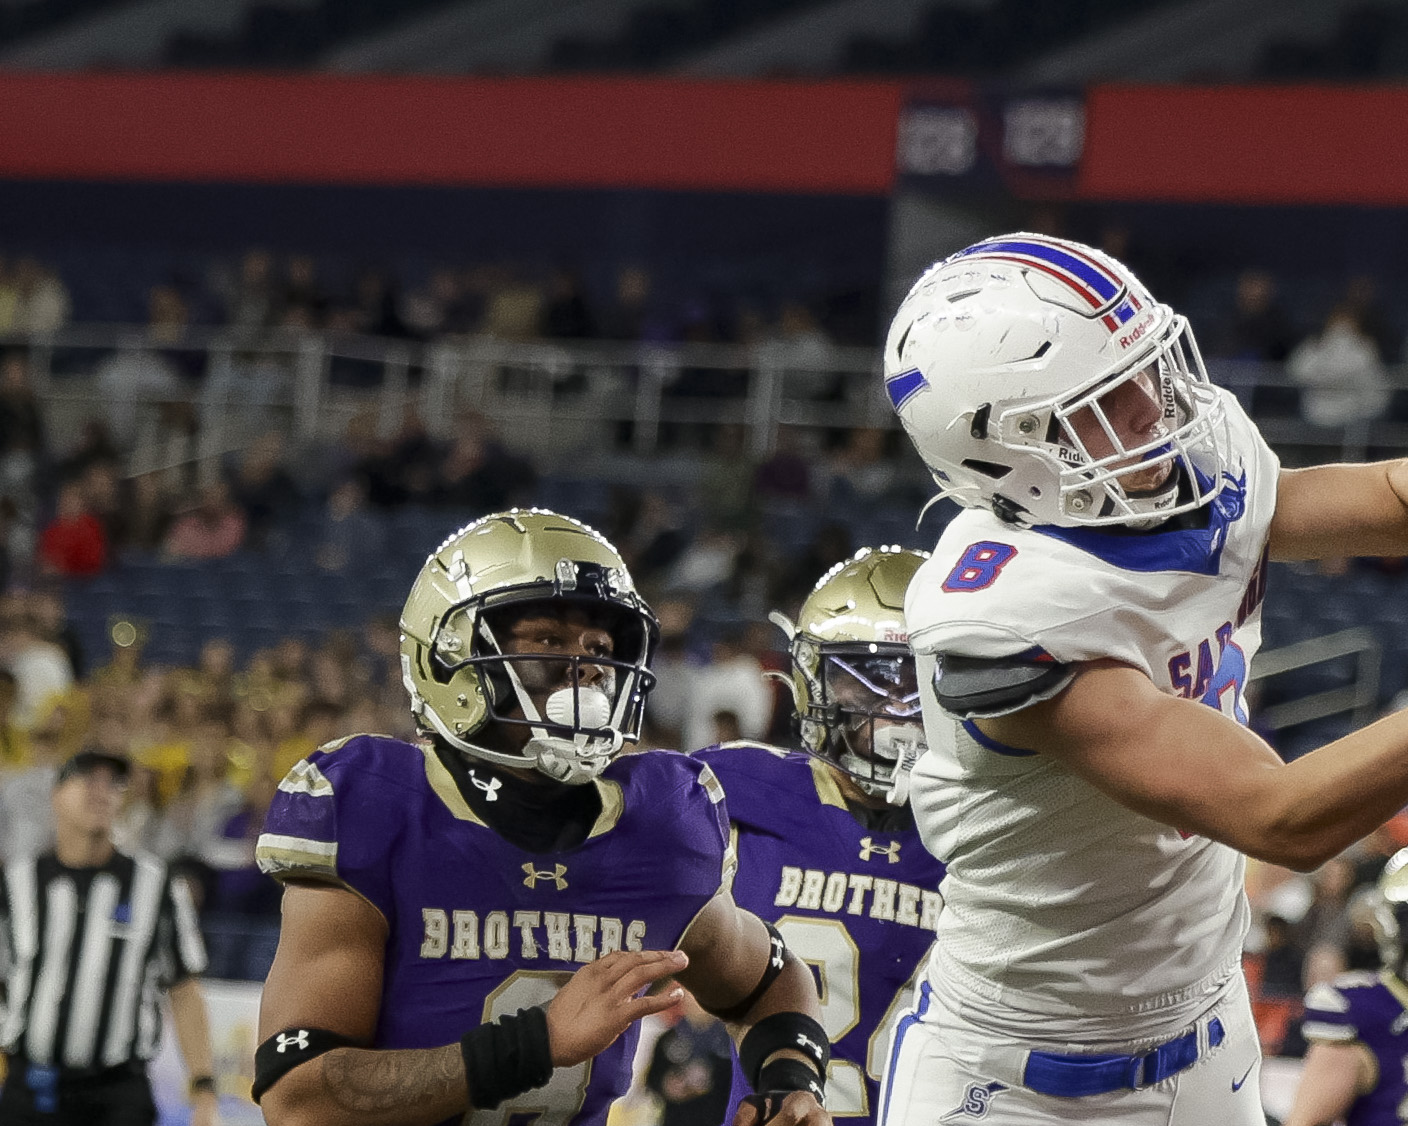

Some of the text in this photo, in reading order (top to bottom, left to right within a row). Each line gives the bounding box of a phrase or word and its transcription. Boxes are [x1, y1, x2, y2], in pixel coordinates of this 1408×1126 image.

[1119, 313, 1155, 349] Ridd
[941, 541, 1019, 593] 8
[420, 907, 647, 964] BROTHERS
